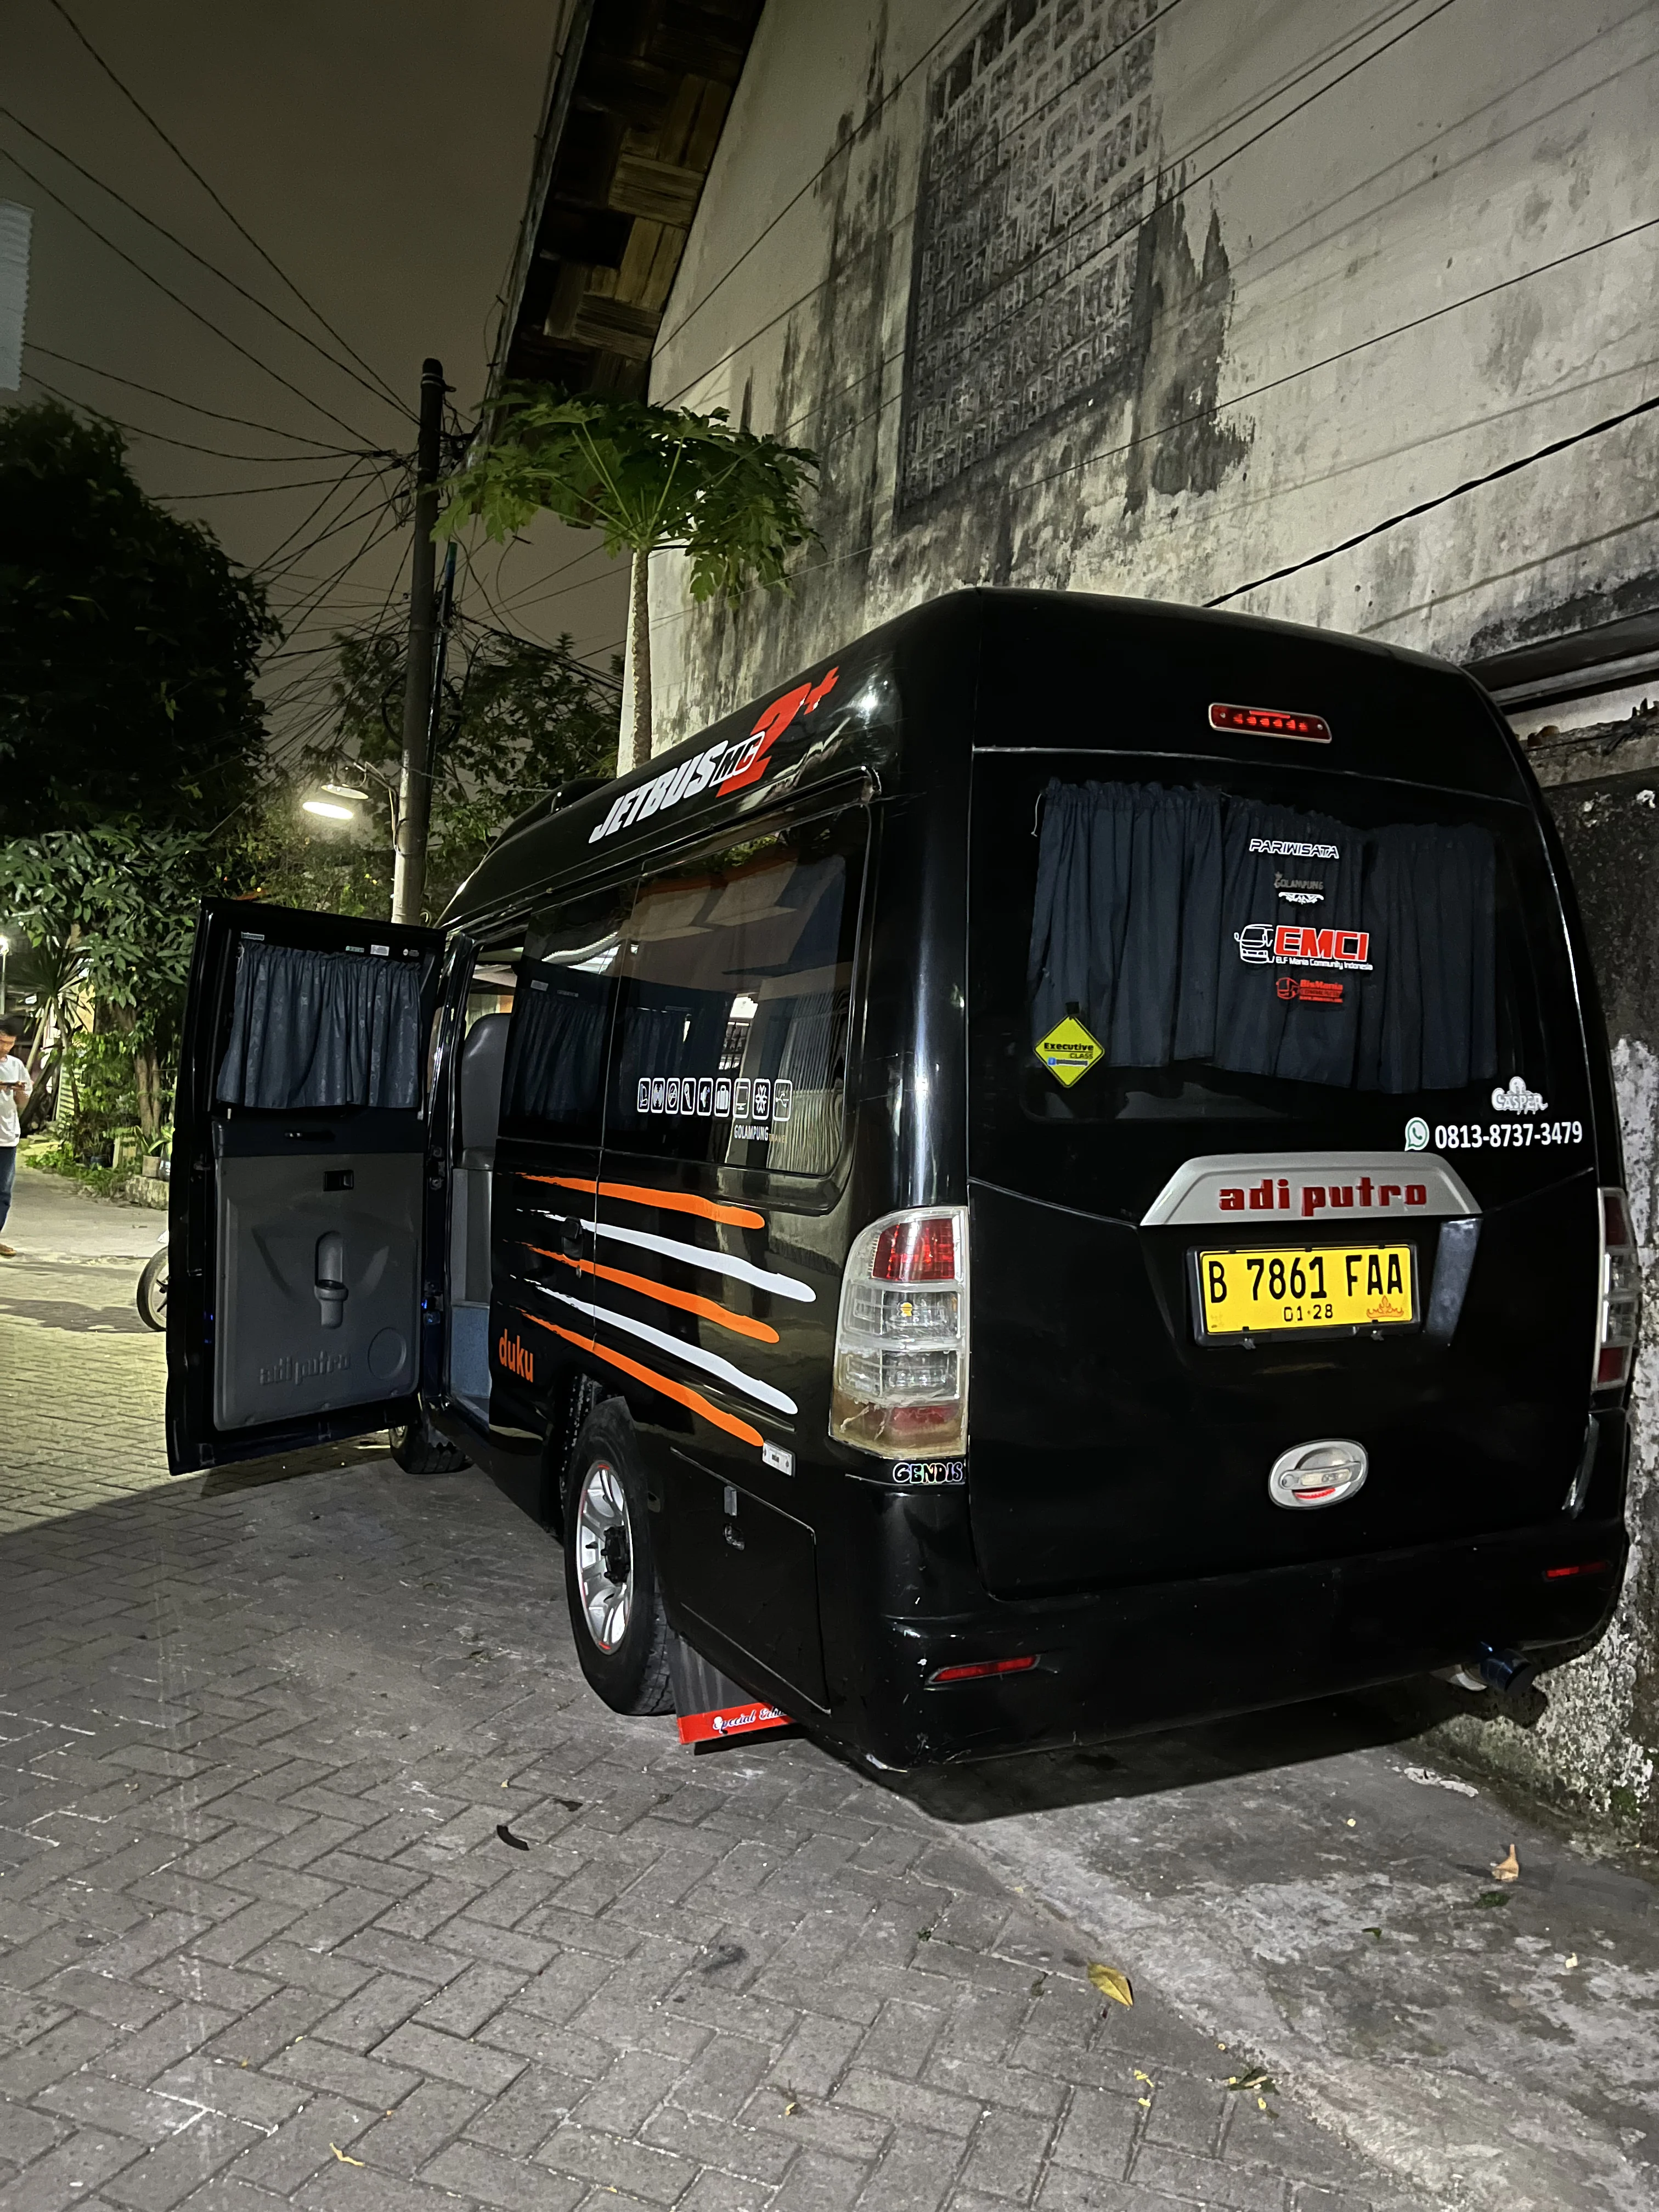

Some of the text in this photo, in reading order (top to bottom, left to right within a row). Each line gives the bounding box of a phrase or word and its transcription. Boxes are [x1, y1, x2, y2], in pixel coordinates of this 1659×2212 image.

[589, 740, 729, 844] JETBUS
[1249, 839, 1339, 859] PARIWISATA
[1274, 879, 1324, 890] GOLAMPUNG
[1273, 925, 1369, 962] EMCI
[1289, 957, 1309, 966] Mania
[1310, 958, 1344, 970] Community
[1044, 1042, 1094, 1051] Executive
[1492, 1088, 1548, 1115] CASPER
[734, 1125, 769, 1141] GOLAMPUNG
[1435, 1121, 1583, 1149] 0813-8737-3479
[1219, 1177, 1426, 1216] adi putro
[1209, 1254, 1403, 1303] B 7861 FAA
[499, 1328, 533, 1383] duku
[893, 1462, 963, 1483] GENDIS
[713, 1709, 757, 1734] Special
